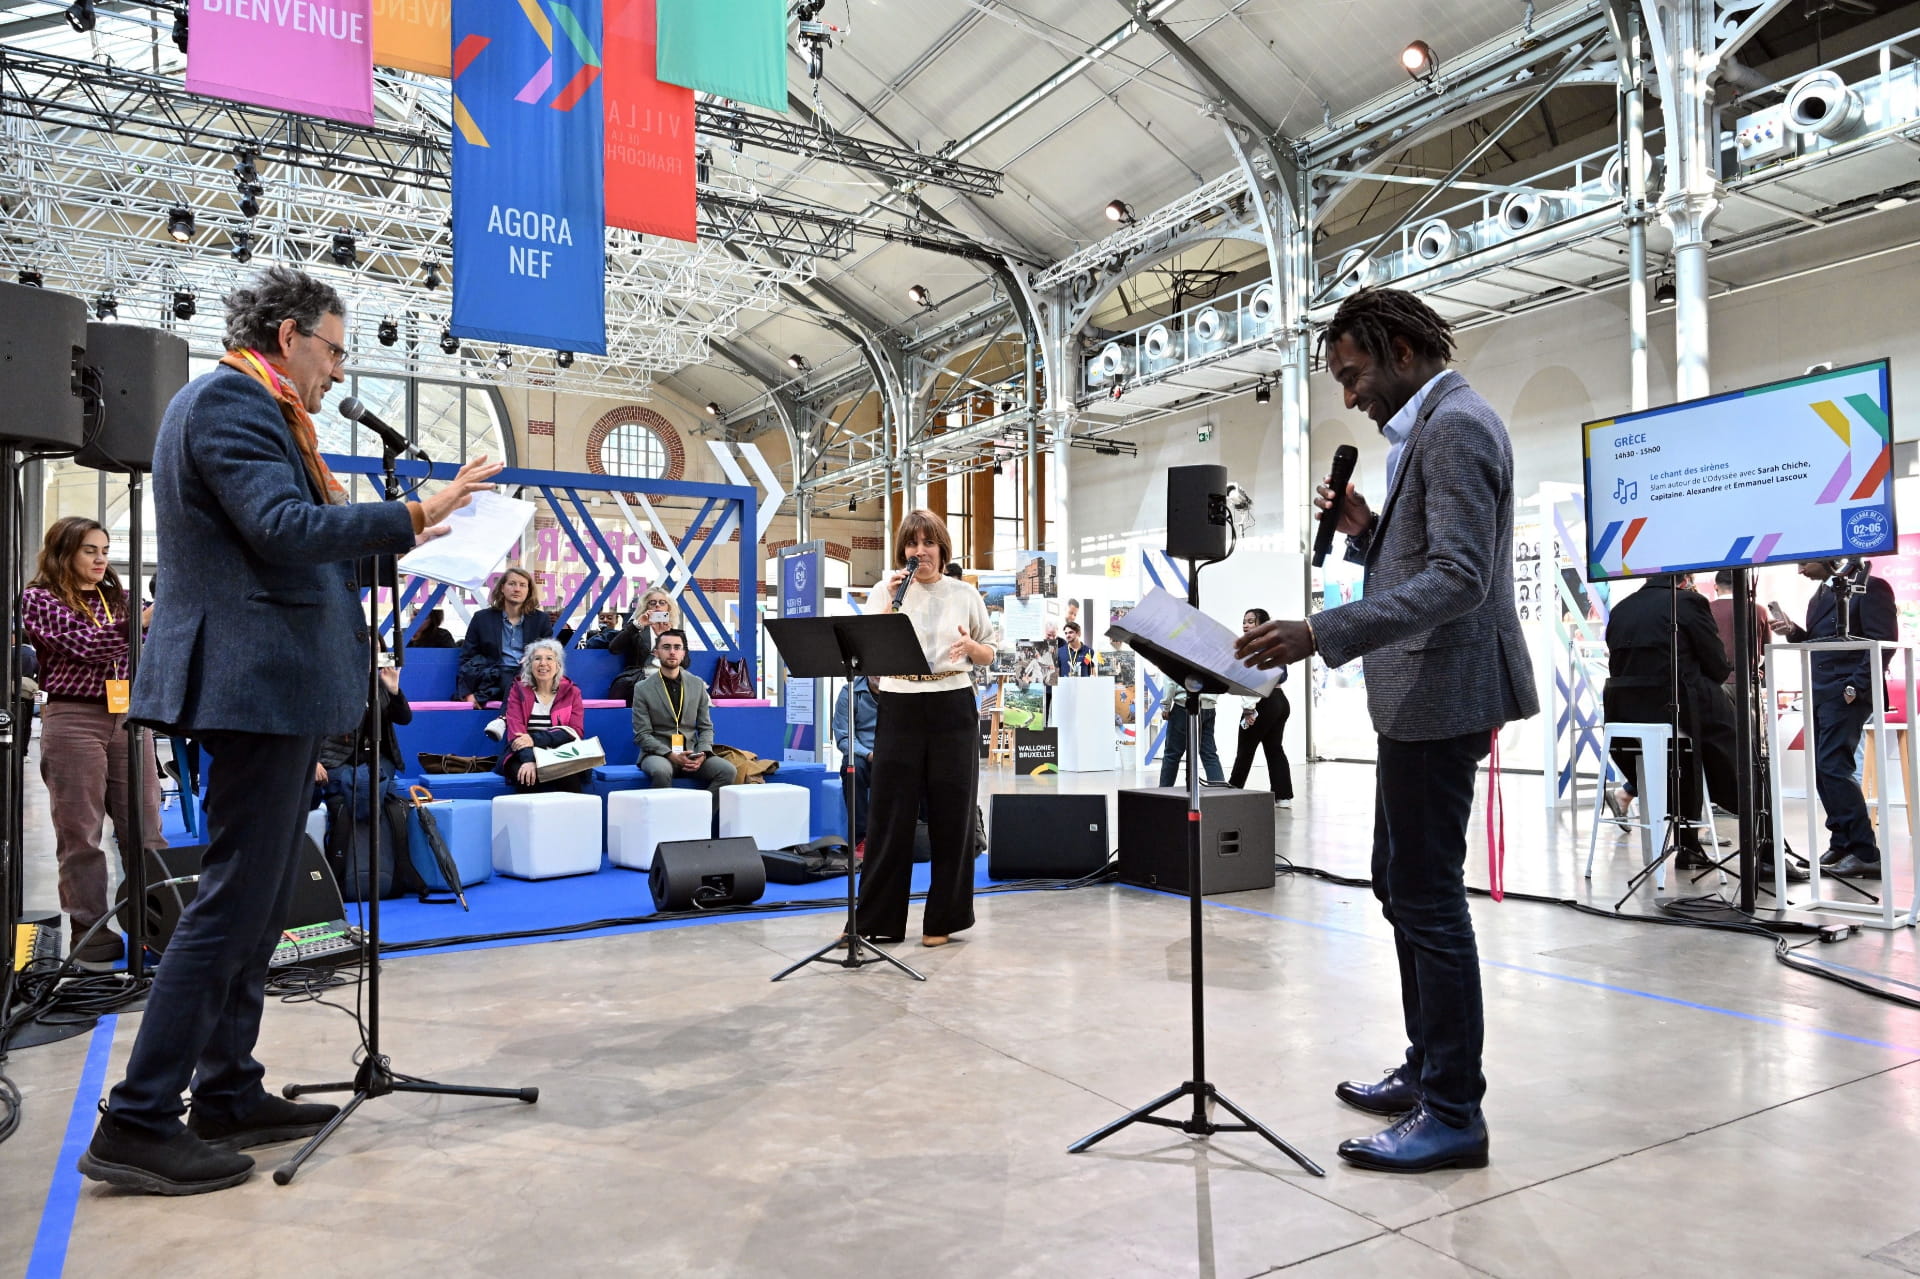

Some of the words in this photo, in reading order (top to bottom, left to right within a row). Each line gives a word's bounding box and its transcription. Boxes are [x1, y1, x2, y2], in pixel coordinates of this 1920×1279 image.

[487, 204, 573, 247] AGORA
[509, 245, 553, 280] NEF
[1614, 433, 1647, 448] GRÈCE
[1615, 450, 1635, 460] 14h30
[1640, 445, 1661, 455] 15h00
[1650, 473, 1659, 481] Le
[1660, 469, 1682, 479] chant
[1684, 466, 1698, 475] des
[1700, 462, 1729, 473] sirènes
[1650, 482, 1667, 491] Slam
[1667, 478, 1691, 489] autour
[1692, 477, 1701, 485] de
[1702, 472, 1738, 484] L'Odyssée
[1739, 469, 1756, 478] avec
[1757, 464, 1779, 475] Sarah
[1781, 460, 1811, 471] Chiche,
[1686, 484, 1723, 496] Alexandre
[1733, 476, 1774, 489] Emmanuel
[1775, 472, 1808, 483] Lascoux
[1018, 744, 1056, 752] WALLONIE-
